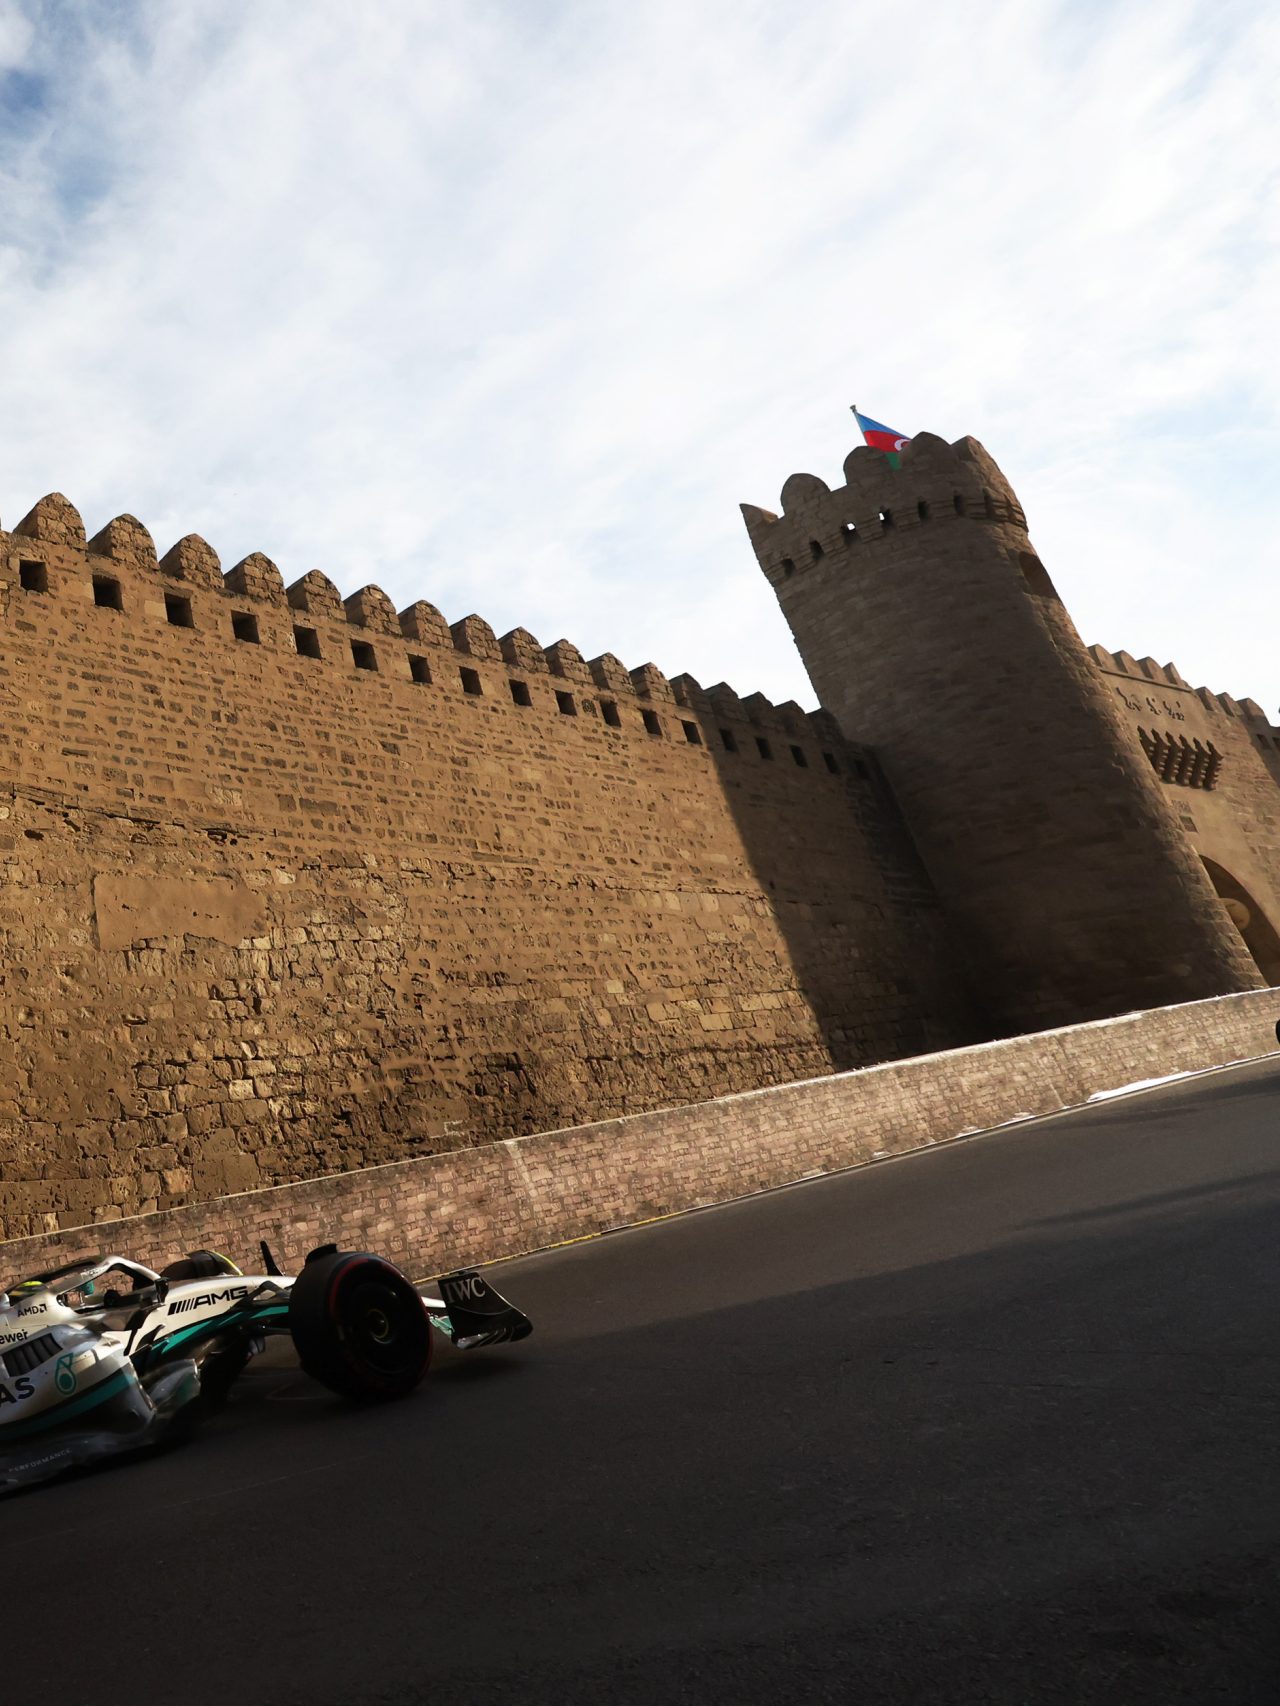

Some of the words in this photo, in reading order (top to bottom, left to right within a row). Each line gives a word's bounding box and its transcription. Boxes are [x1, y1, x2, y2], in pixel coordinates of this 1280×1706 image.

[193, 1286, 248, 1309] AMG
[443, 1277, 486, 1304] IWC
[17, 1305, 39, 1317] AMD
